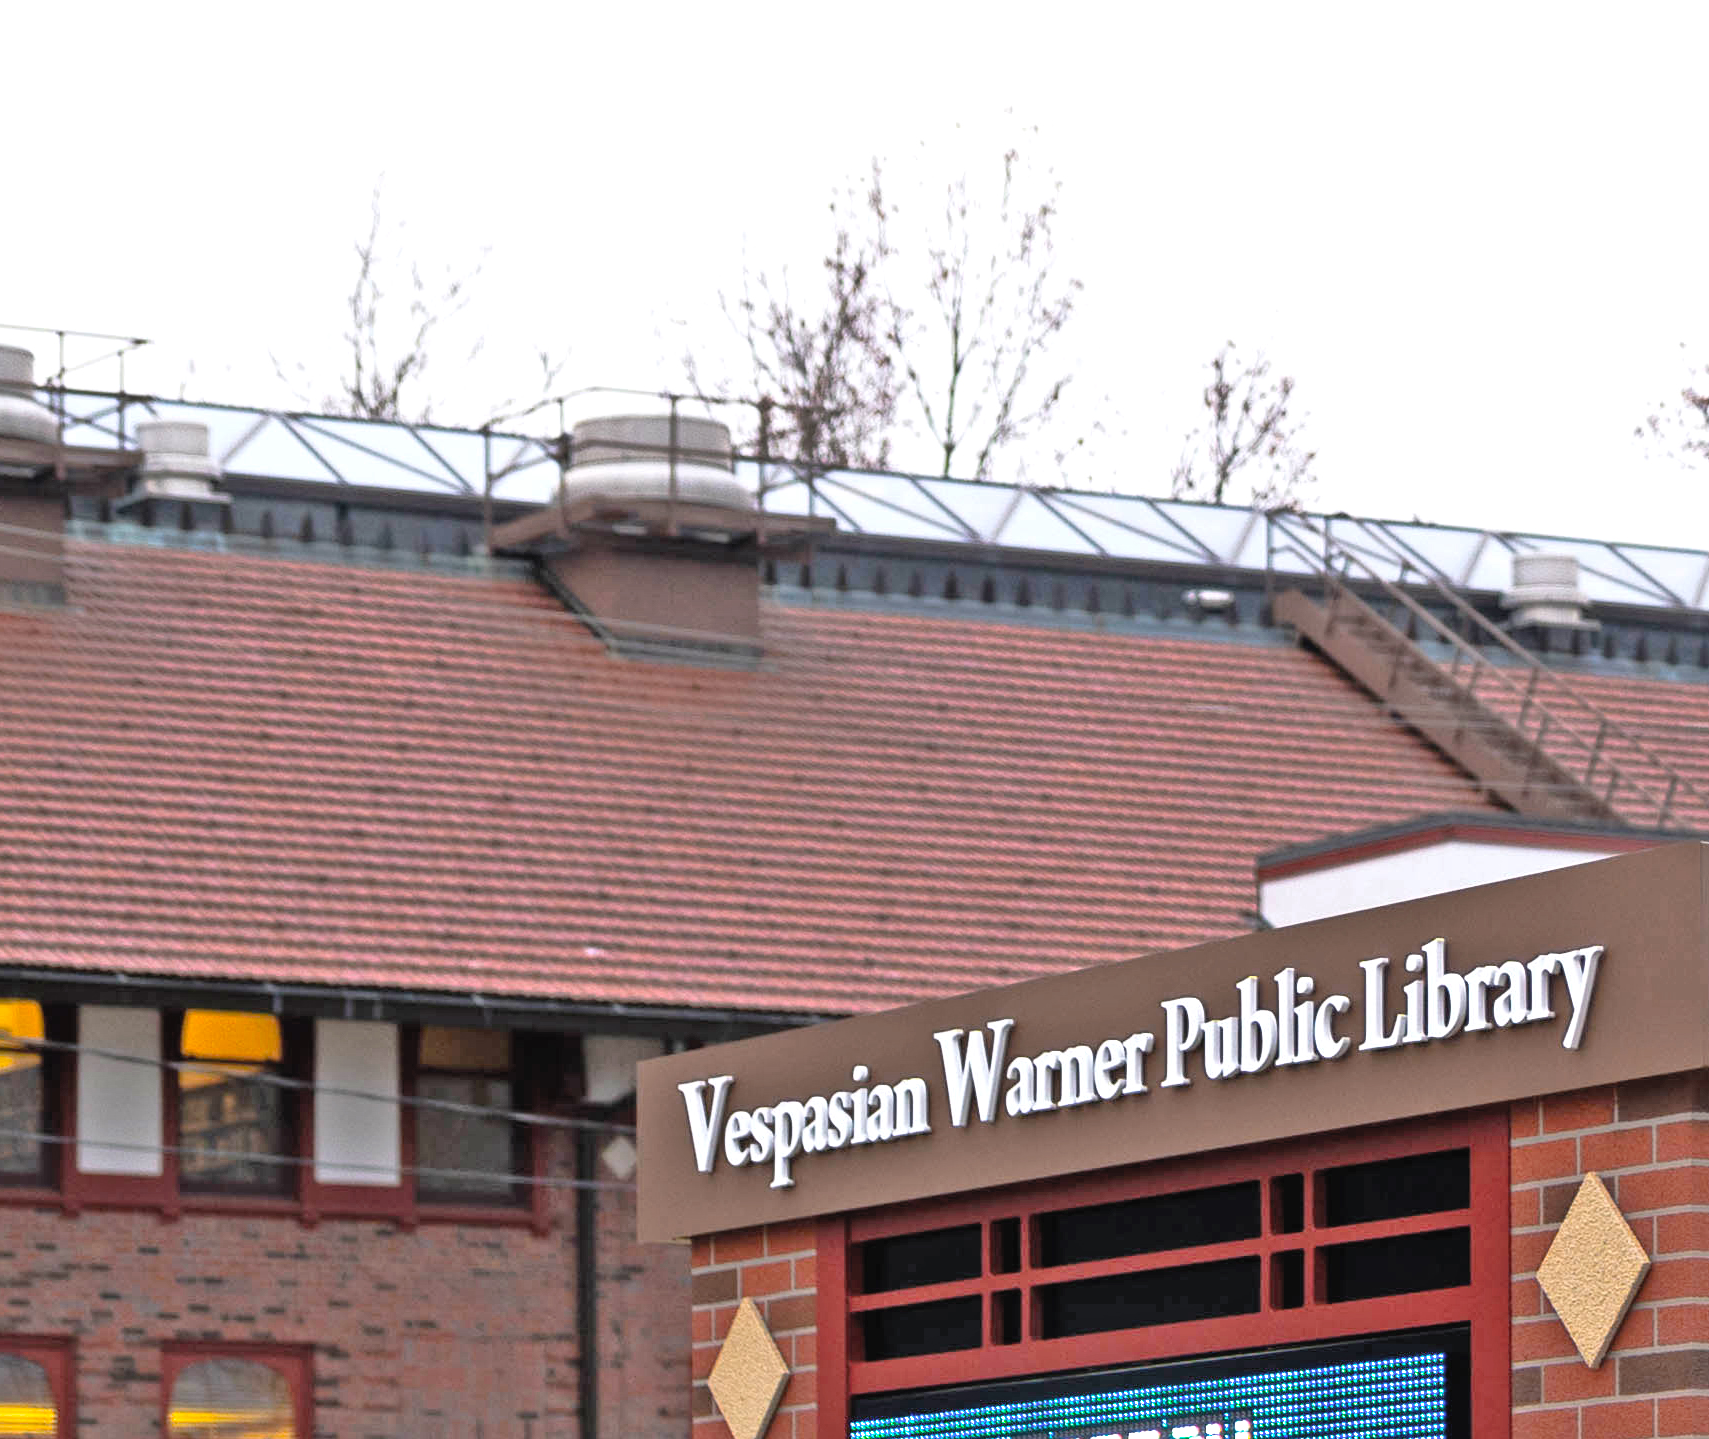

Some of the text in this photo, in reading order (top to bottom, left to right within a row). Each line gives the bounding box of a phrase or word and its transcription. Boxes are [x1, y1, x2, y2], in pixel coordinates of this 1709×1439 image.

[679, 937, 1605, 1188] Vespasian Warner Public Library
